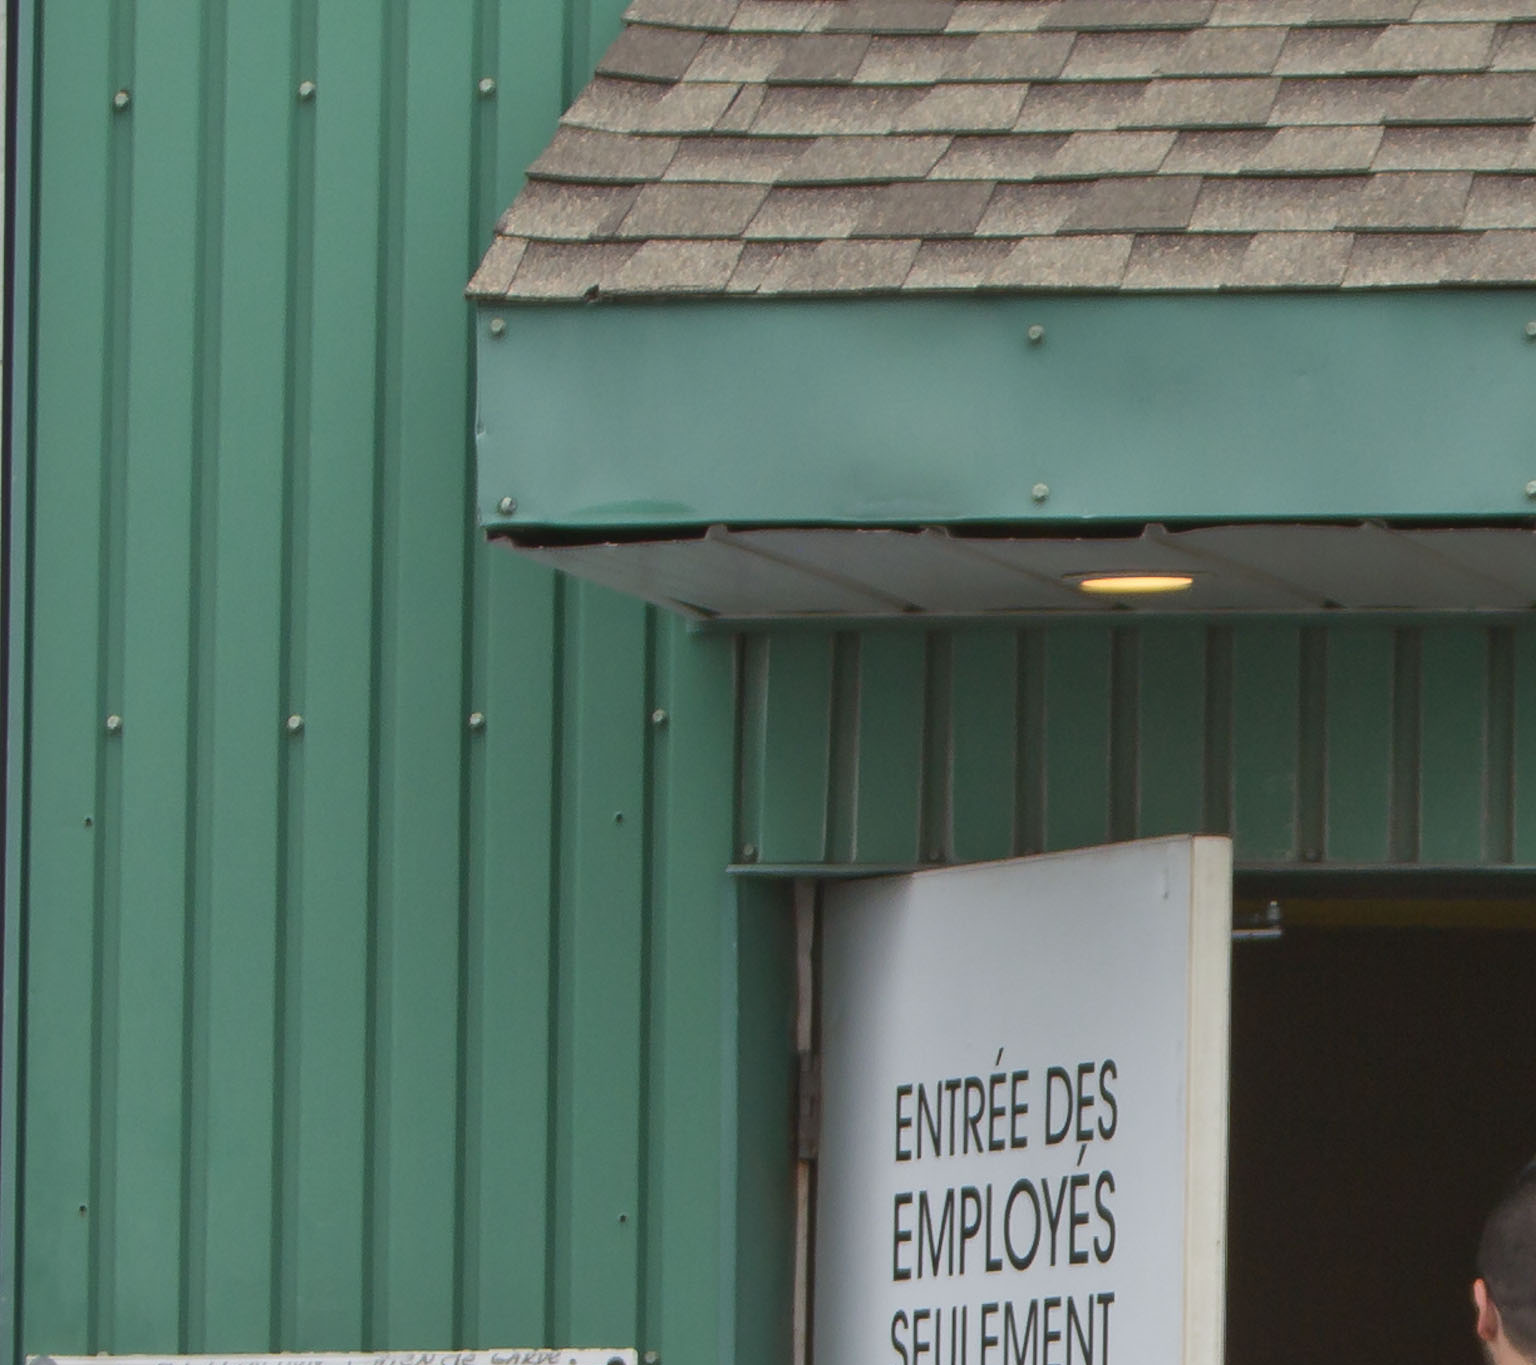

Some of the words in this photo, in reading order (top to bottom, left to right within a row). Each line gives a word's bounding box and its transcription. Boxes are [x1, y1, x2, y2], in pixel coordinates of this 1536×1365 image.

[895, 1047, 1029, 1162] ENTRÉE
[1044, 1058, 1118, 1146] DES
[891, 1143, 1116, 1282] EMPLOYÉS
